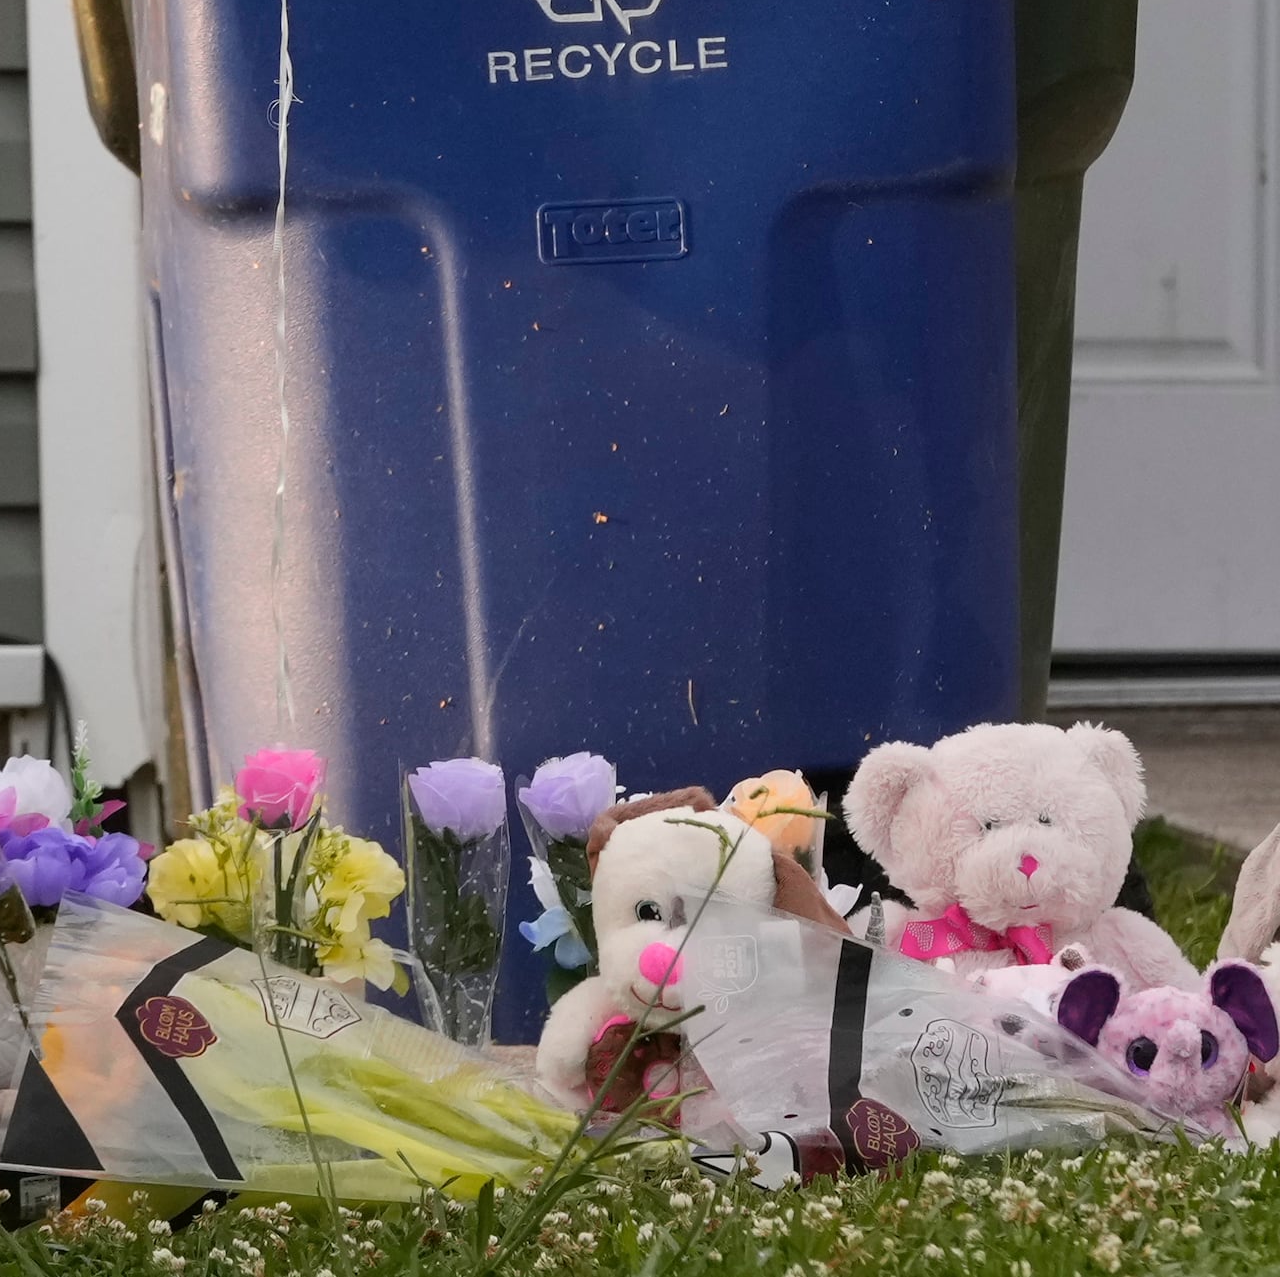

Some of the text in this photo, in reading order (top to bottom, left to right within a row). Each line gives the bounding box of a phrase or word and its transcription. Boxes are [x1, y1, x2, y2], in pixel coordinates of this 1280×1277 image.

[487, 37, 729, 84] RECYCLE
[155, 1004, 177, 1040] BLOOM
[172, 1009, 195, 1046] HAUS
[865, 1106, 881, 1152] BLOOM
[880, 1112, 897, 1157] HAUS
